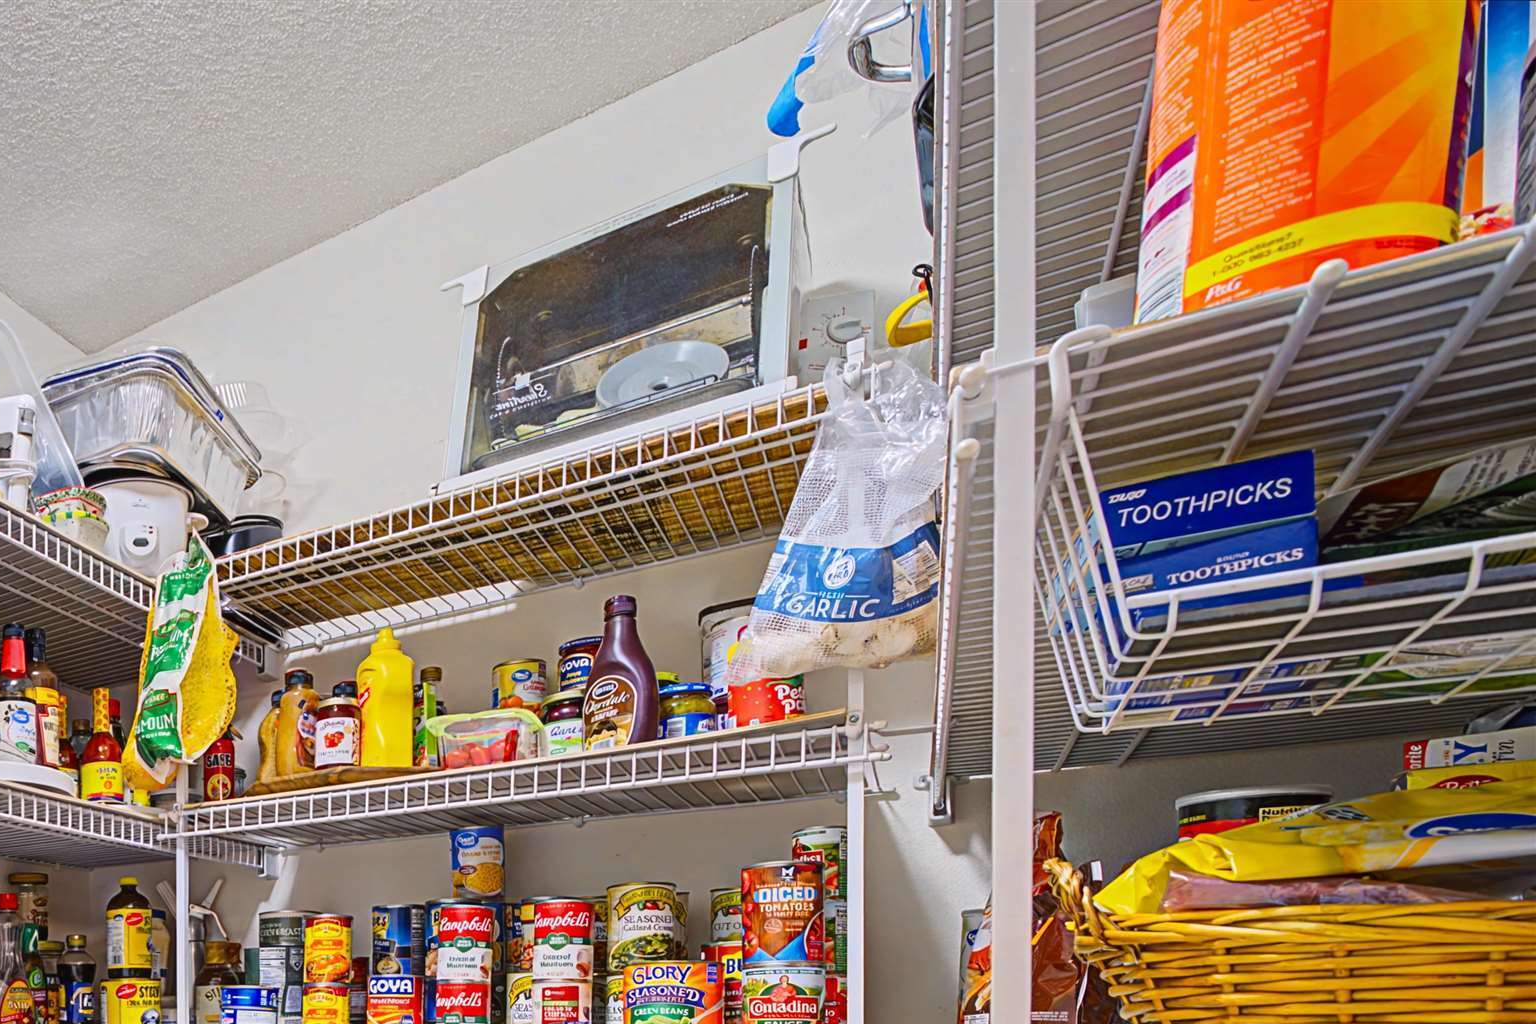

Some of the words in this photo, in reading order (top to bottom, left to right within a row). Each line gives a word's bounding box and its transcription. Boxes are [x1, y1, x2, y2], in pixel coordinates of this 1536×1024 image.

[1117, 477, 1293, 528] TOOTHPICKS
[1167, 547, 1304, 586] TOOTHPICKS
[786, 594, 881, 620] GARLIC
[757, 886, 816, 903] DICED
[759, 903, 815, 912] TOMATOES
[632, 965, 693, 985] GLORY
[369, 978, 413, 994] GOYA
[627, 986, 700, 1003] SEASONED
[659, 1007, 689, 1016] BEANS
[750, 1000, 817, 1014] Contadina
